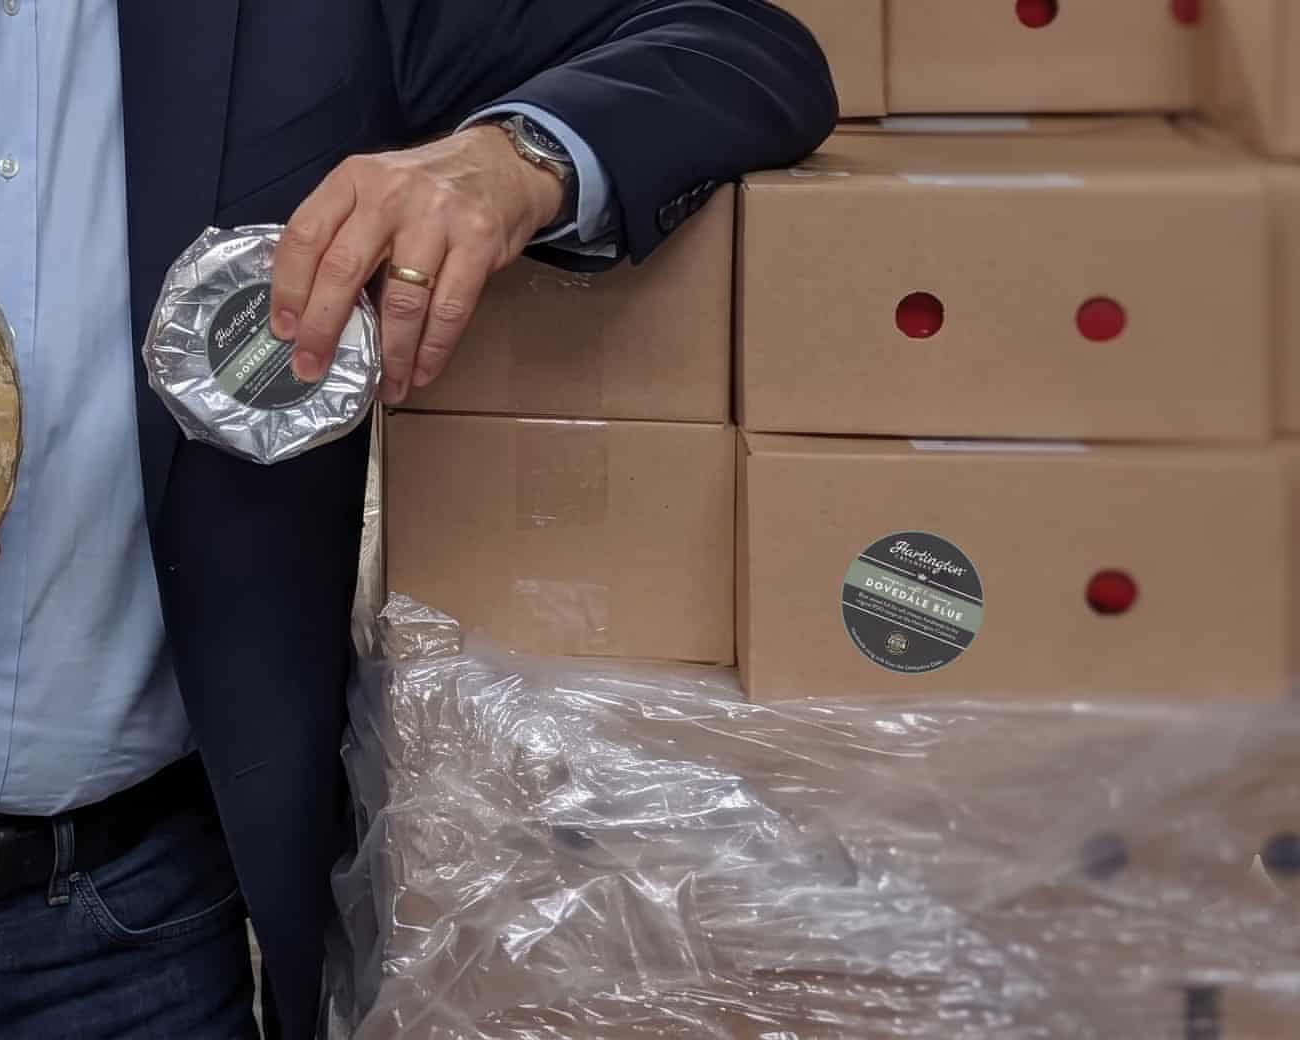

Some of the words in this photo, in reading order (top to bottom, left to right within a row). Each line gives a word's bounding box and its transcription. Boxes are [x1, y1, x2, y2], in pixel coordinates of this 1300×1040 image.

[889, 540, 966, 576] Hartington
[864, 577, 928, 609] DOVEDALE
[932, 603, 964, 621] BLUE
